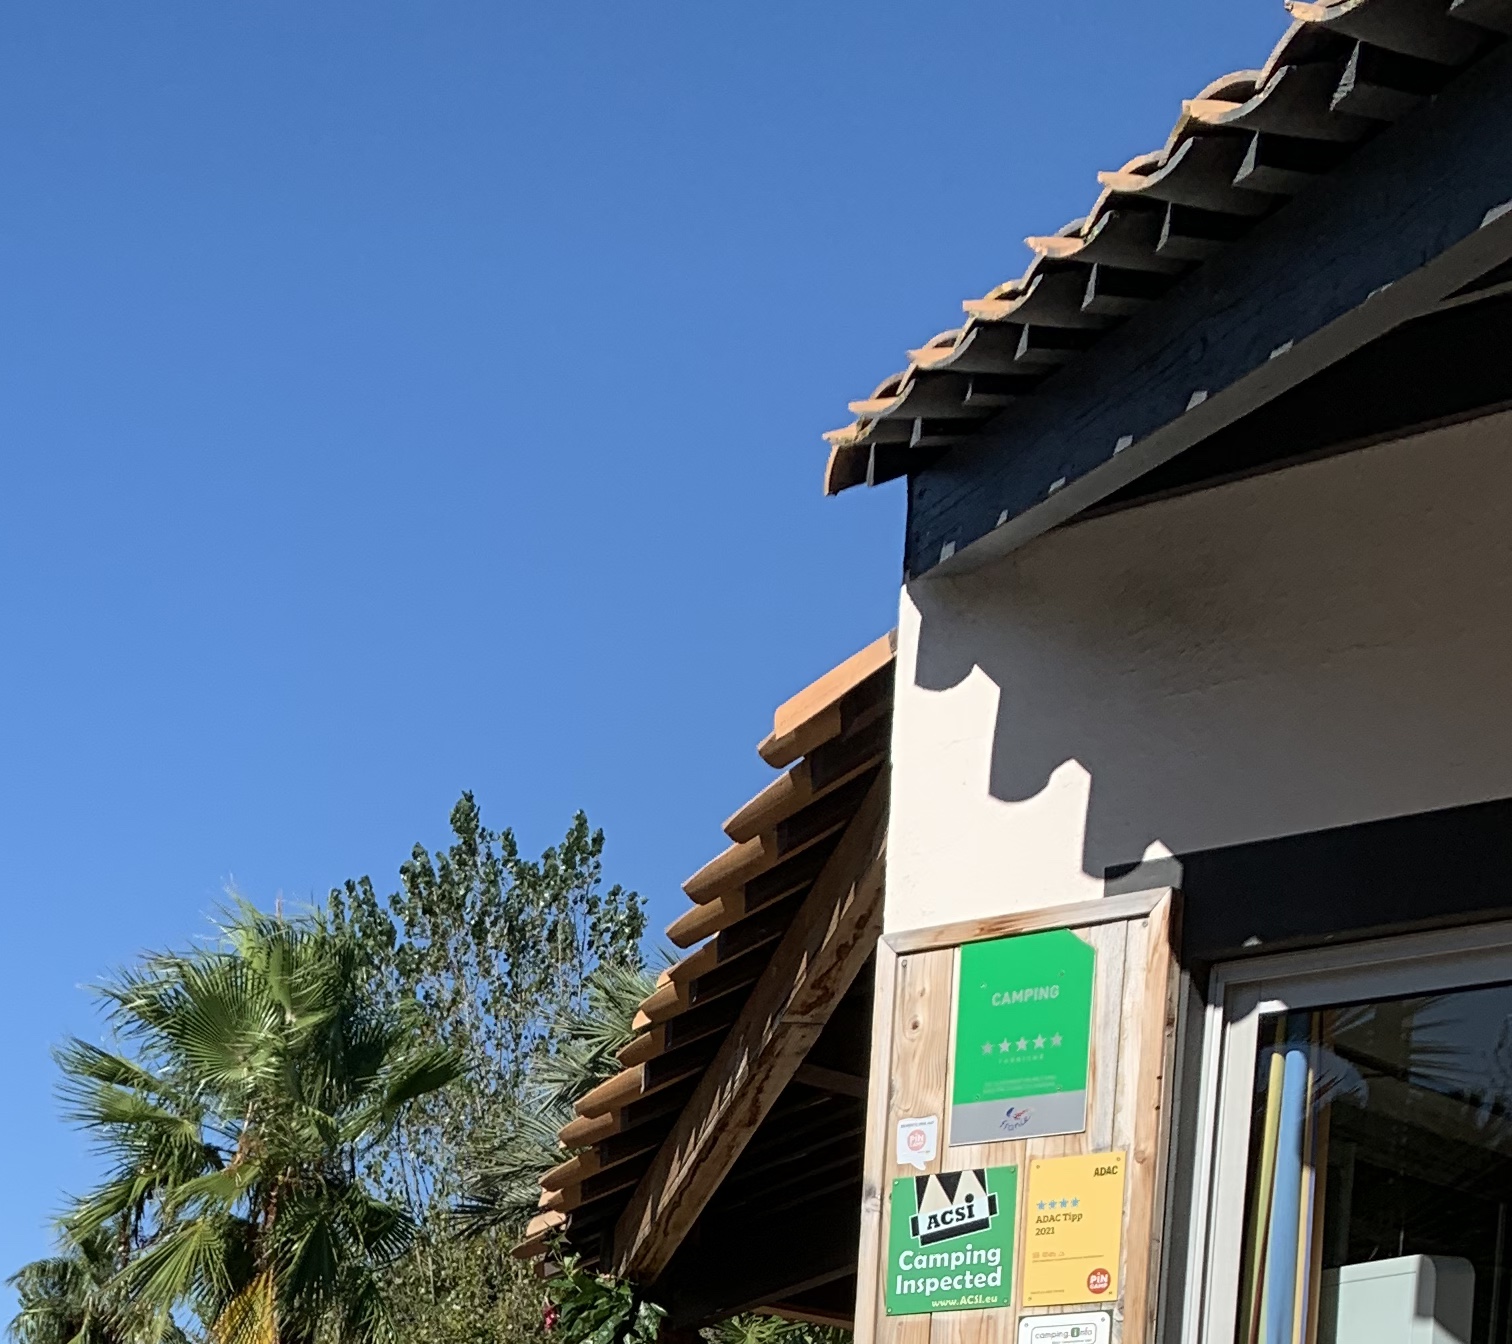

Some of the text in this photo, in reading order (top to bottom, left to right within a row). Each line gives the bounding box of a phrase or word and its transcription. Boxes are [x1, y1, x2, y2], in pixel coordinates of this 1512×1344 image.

[991, 985, 1060, 1007] CAMPING
[1093, 1165, 1119, 1177] ADAC
[1035, 1212, 1083, 1224] ADAC Tipp
[1035, 1226, 1056, 1236] 2021
[898, 1243, 1002, 1271] Camping
[895, 1265, 1003, 1297] Inspected
[931, 1294, 998, 1308] www.ACSI.eu
